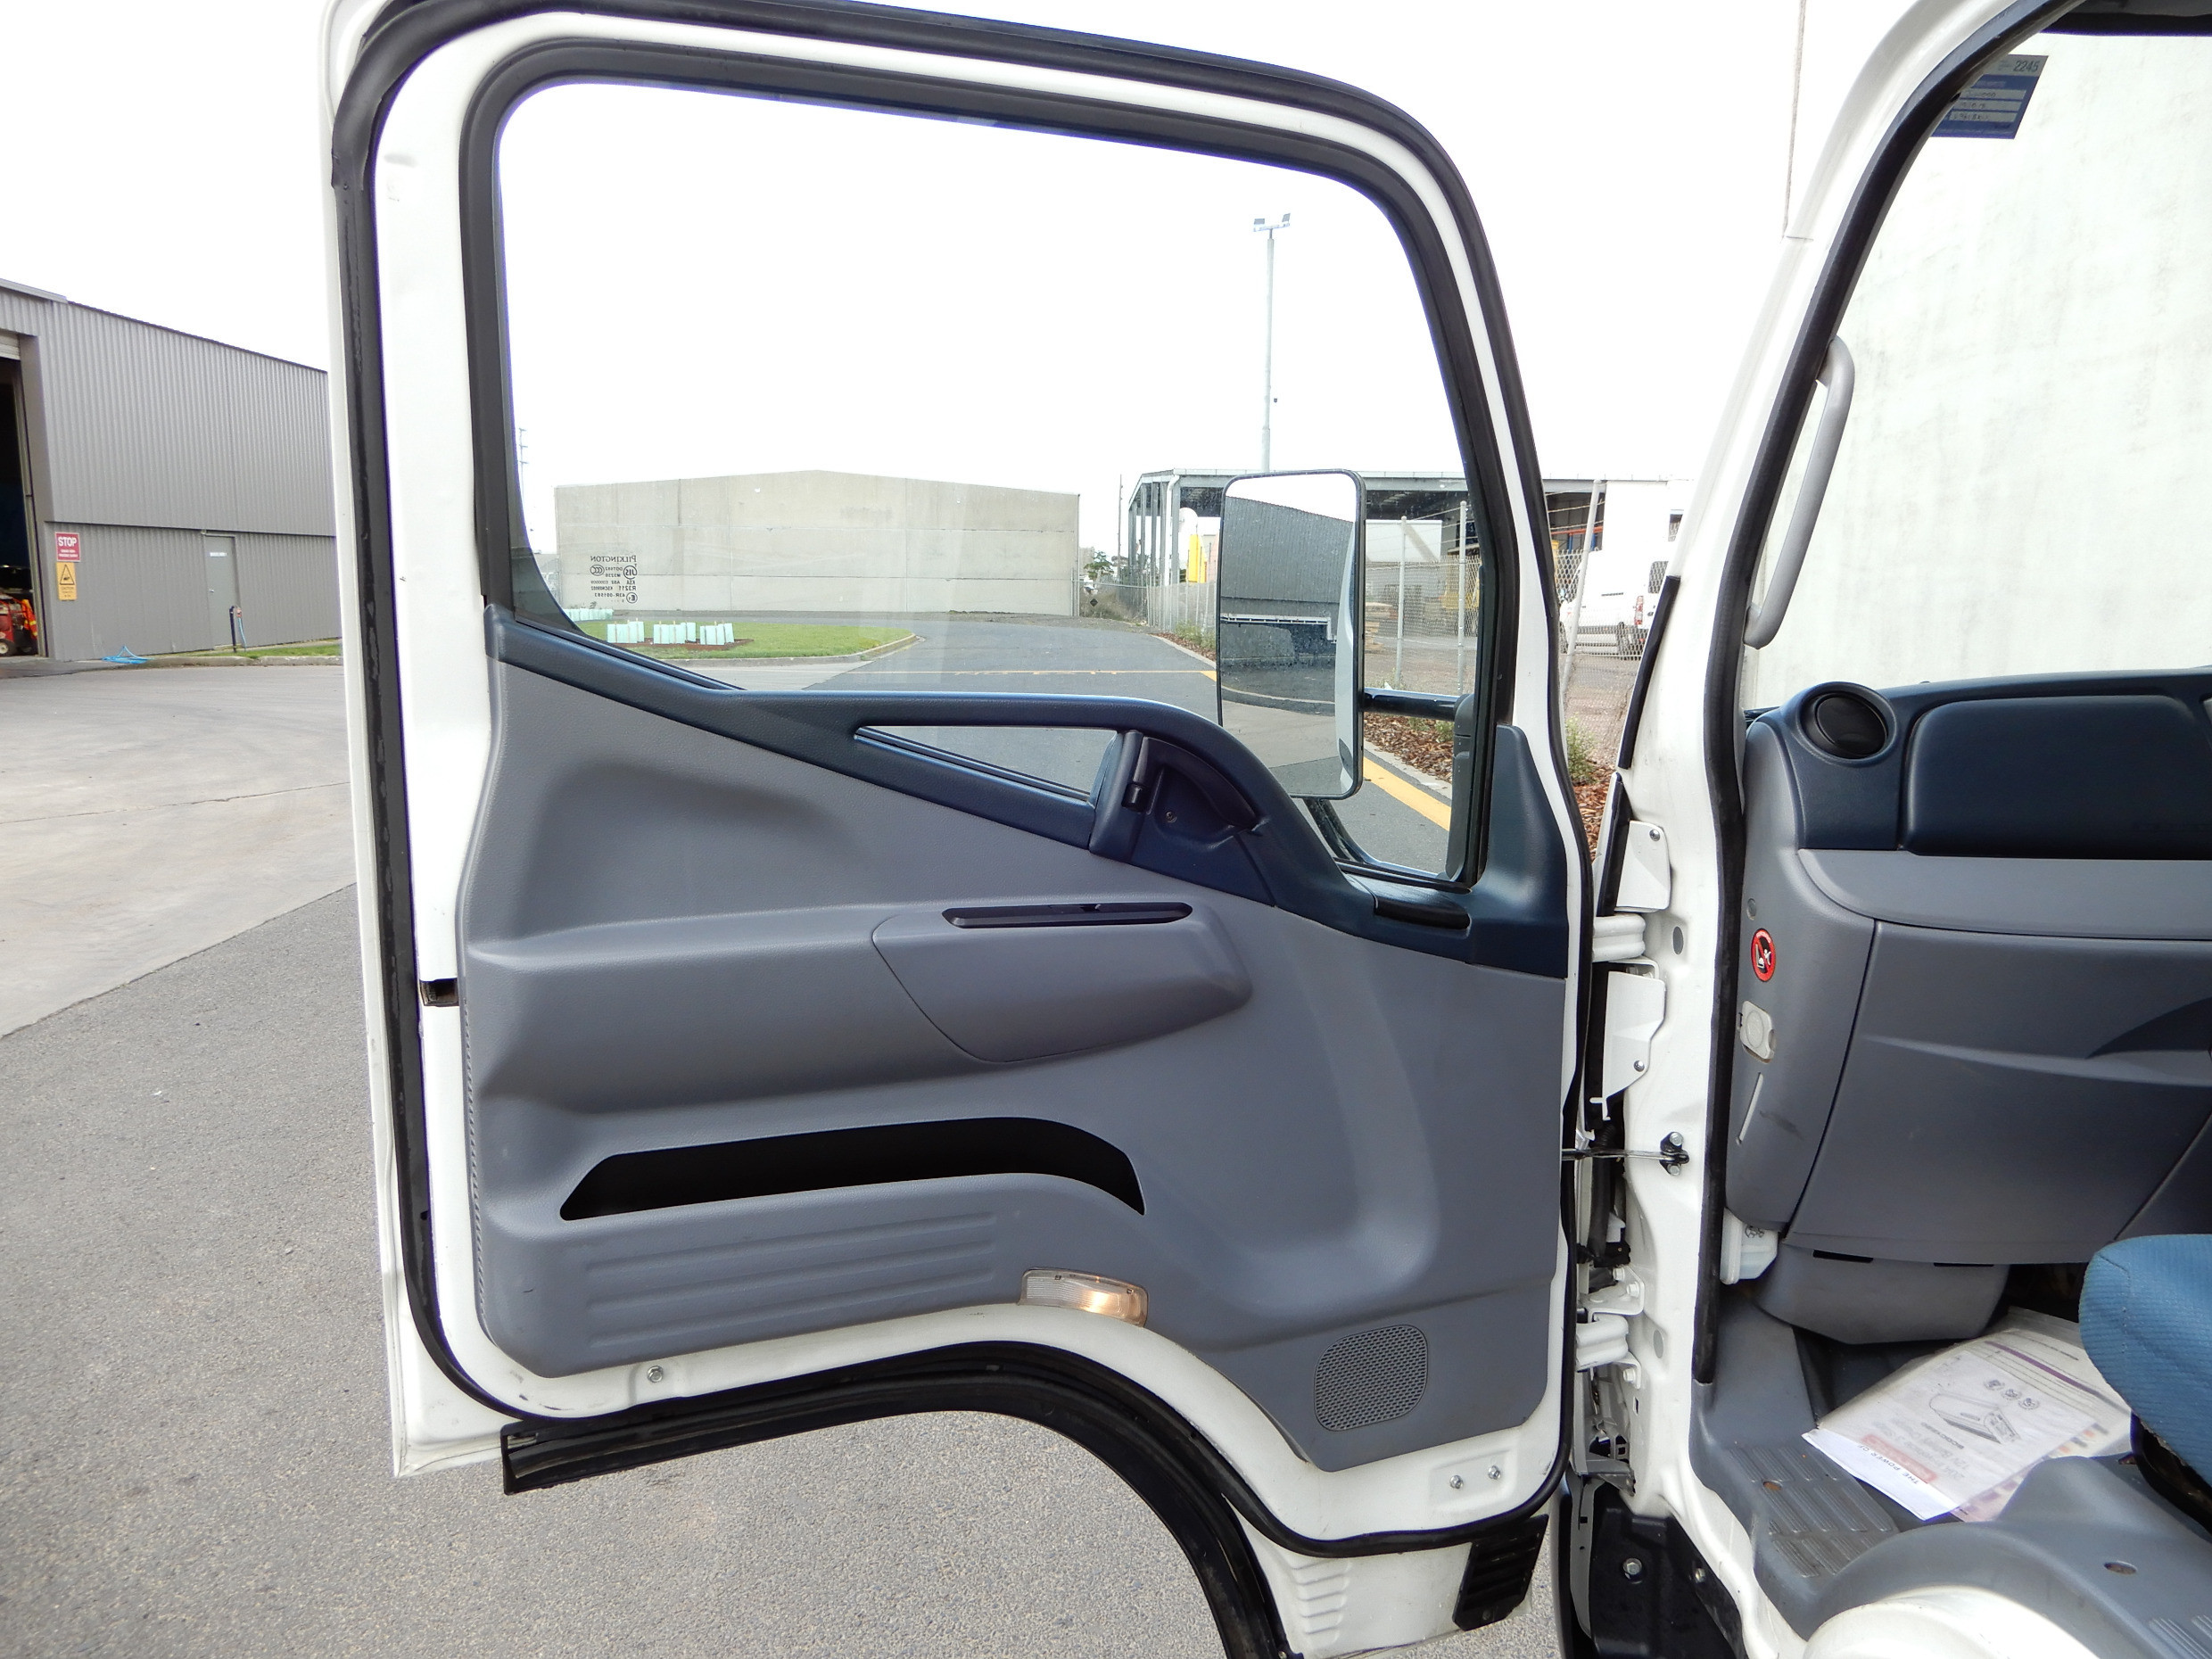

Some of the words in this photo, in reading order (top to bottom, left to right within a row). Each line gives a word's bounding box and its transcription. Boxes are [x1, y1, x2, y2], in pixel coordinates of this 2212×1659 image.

[58, 536, 77, 547] STOP
[1870, 1452, 1901, 1471] POWER
[1902, 1472, 1919, 1484] THE
